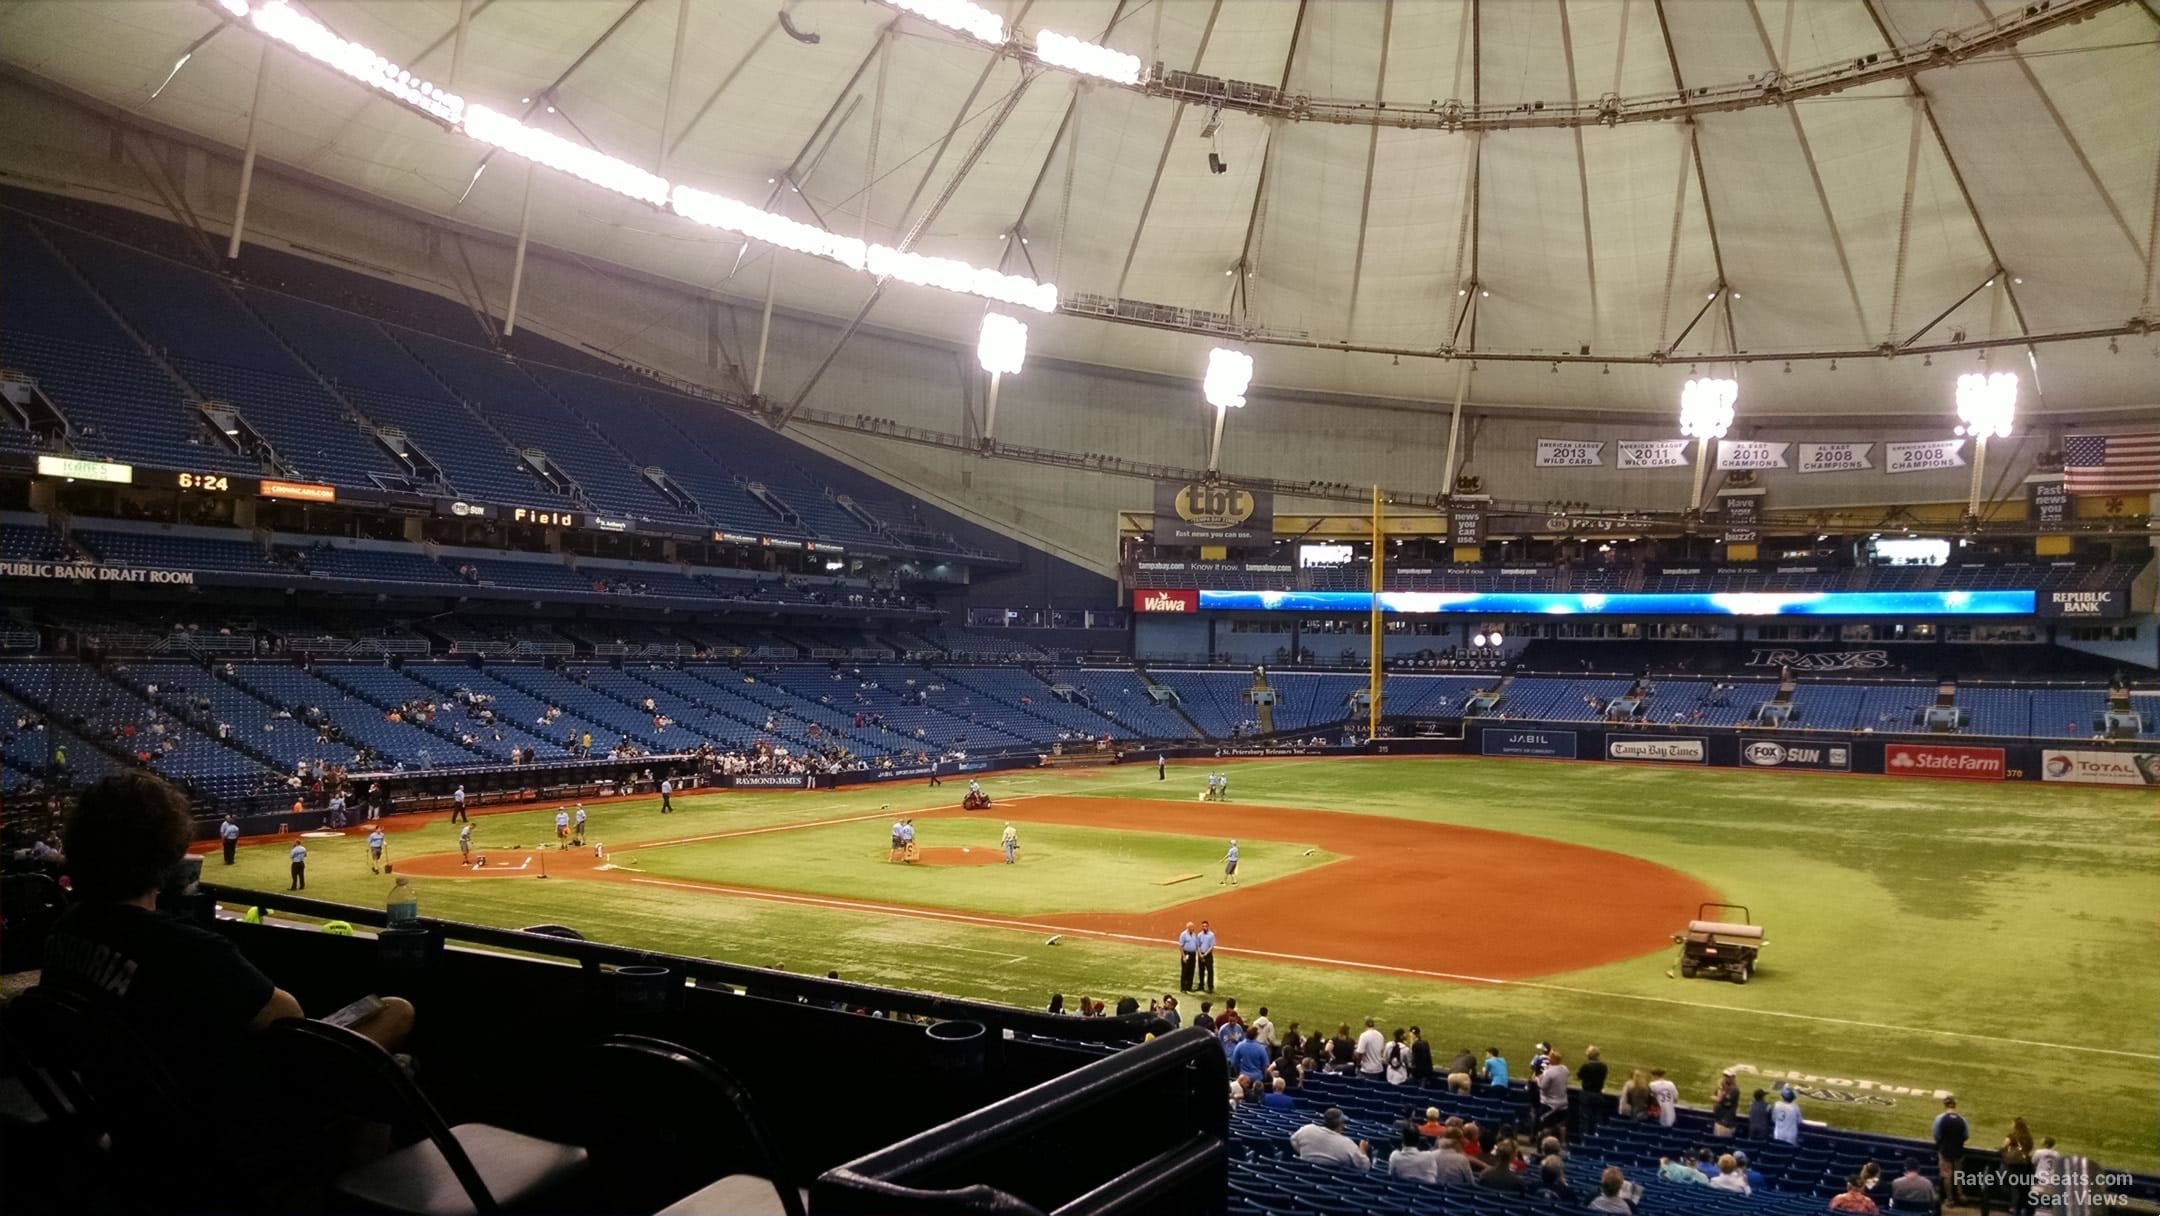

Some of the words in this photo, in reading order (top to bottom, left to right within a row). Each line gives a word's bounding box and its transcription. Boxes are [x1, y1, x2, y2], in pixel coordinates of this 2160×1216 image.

[1553, 449, 1586, 458] 2013
[1635, 449, 1668, 459] 2011
[1733, 450, 1769, 460] 2010
[1815, 451, 1852, 461] 2008
[1904, 450, 1944, 461] 2008
[1804, 461, 1862, 470] CHAMPIONS
[1892, 459, 1954, 470] CHAMPIONS
[178, 473, 229, 492] 6:24
[1457, 476, 1479, 488] tbt
[2037, 486, 2062, 495] Fast
[1186, 484, 1244, 516] tbt
[1727, 499, 1754, 508] Have
[2036, 495, 2067, 504] news
[470, 506, 485, 515] SUN
[2040, 505, 2062, 515] you
[514, 508, 572, 526] Field
[1455, 513, 1479, 521] news
[1458, 521, 1476, 529] you
[1211, 531, 1223, 539] you
[1457, 536, 1477, 544] use.
[1725, 532, 1757, 542] buzz?
[1139, 562, 1184, 571] tampabay.com
[1191, 563, 1213, 571] Know
[1246, 563, 1292, 572] tampabay.com
[0, 563, 52, 578] PUBLIC
[55, 566, 96, 580] BANK
[100, 568, 147, 582] DRAFT
[150, 570, 193, 584] ROOM
[2053, 592, 2111, 602] REPUBLIC
[1145, 597, 1185, 611] Wawa
[2064, 603, 2099, 612] BANK
[1745, 649, 1888, 670] RAYS
[1509, 735, 1548, 744] JABIL
[1232, 748, 1263, 757] Petersburg
[1615, 742, 1647, 756] Tampa
[1649, 742, 1668, 757] Bay
[1669, 743, 1699, 757] Times
[1754, 747, 1777, 757] FOX
[1787, 749, 1820, 763] SUN
[2077, 761, 2135, 773] TOTAL
[2007, 769, 2023, 778] 370
[736, 777, 775, 785] RAYMOND
[776, 777, 801, 785] JAMES
